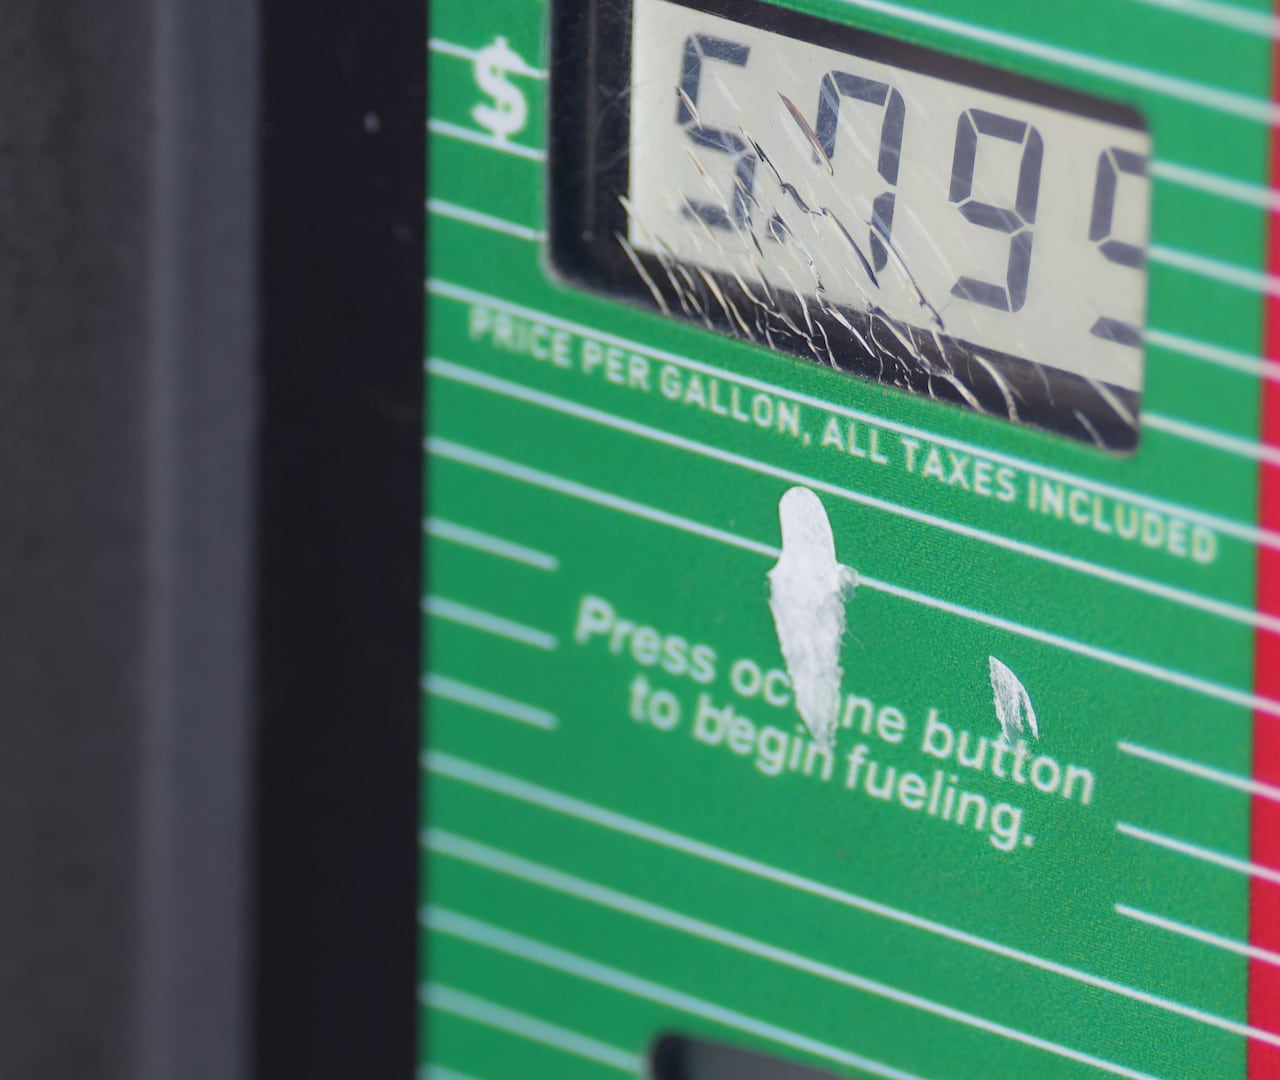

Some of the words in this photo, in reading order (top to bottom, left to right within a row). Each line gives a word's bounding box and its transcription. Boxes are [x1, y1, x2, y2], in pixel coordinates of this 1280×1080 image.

[471, 36, 528, 146] $
[469, 305, 571, 367] PRICE
[581, 338, 650, 392] PER
[660, 365, 812, 447] GALLON,
[823, 417, 888, 465] ALL
[900, 436, 1017, 502] TAXES
[1027, 476, 1217, 565] INCLUDED
[574, 595, 717, 683] Press
[730, 658, 905, 743] ocne
[923, 708, 1094, 805] button
[628, 675, 681, 731] to
[693, 693, 834, 781] begin
[845, 744, 1034, 852] fueling.
